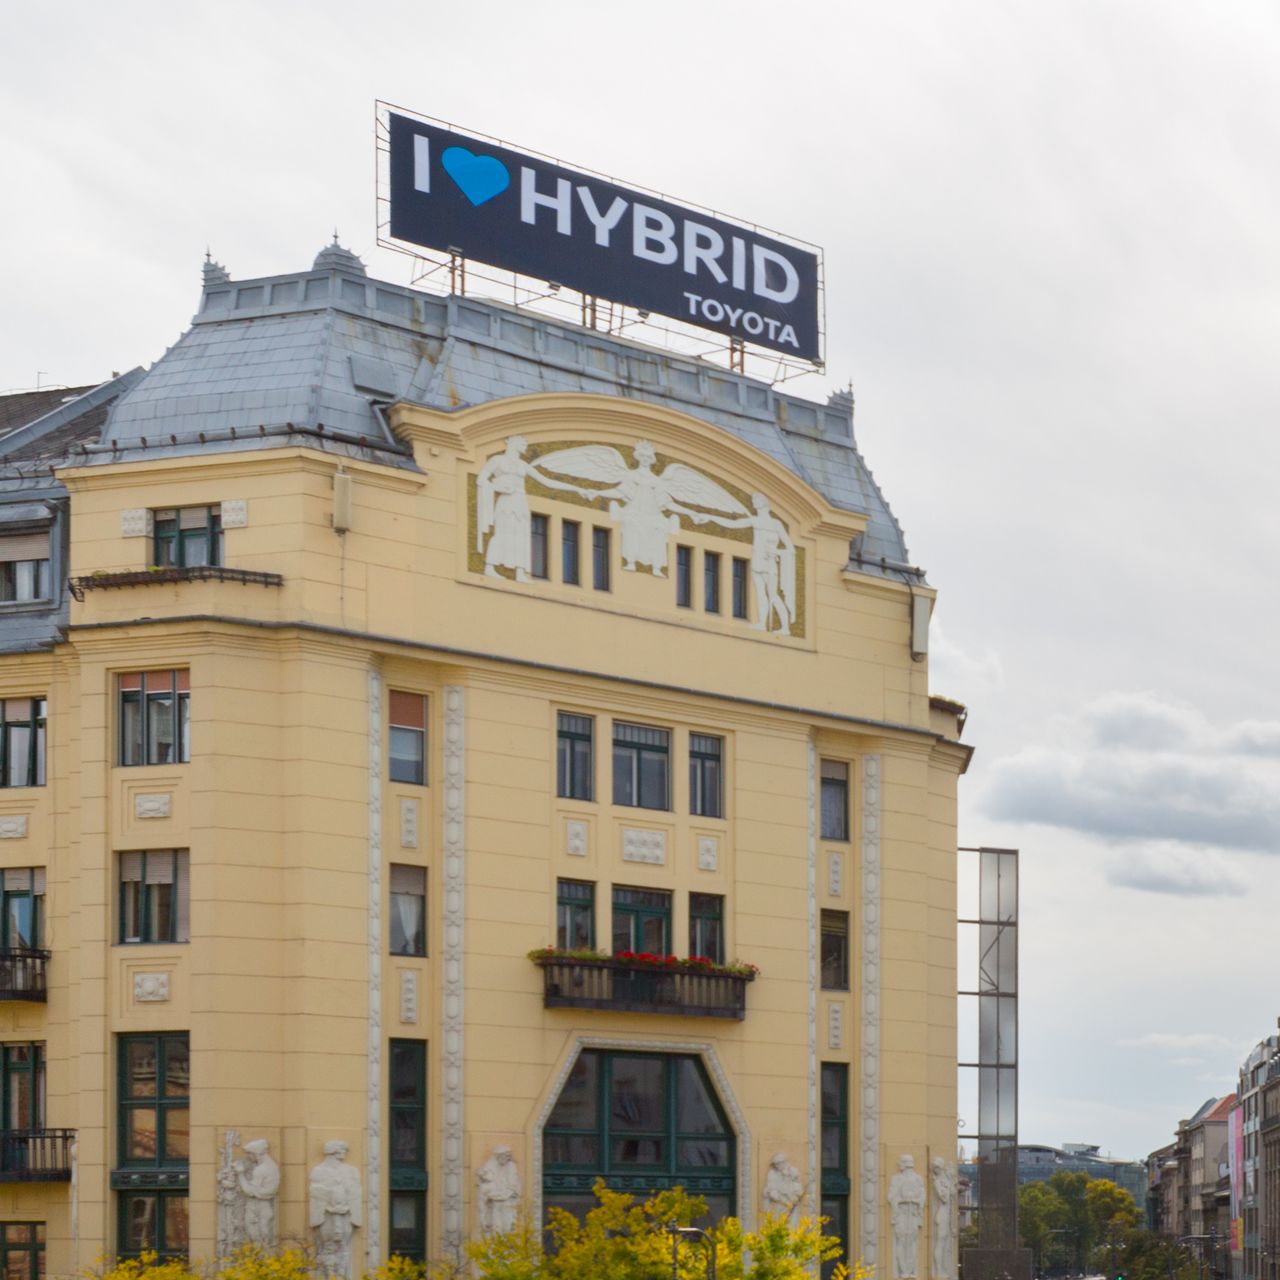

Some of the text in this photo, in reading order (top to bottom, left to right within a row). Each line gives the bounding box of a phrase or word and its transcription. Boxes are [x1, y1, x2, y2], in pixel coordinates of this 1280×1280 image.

[413, 133, 800, 305] I HYBRID
[683, 291, 799, 349] TOYOTA
